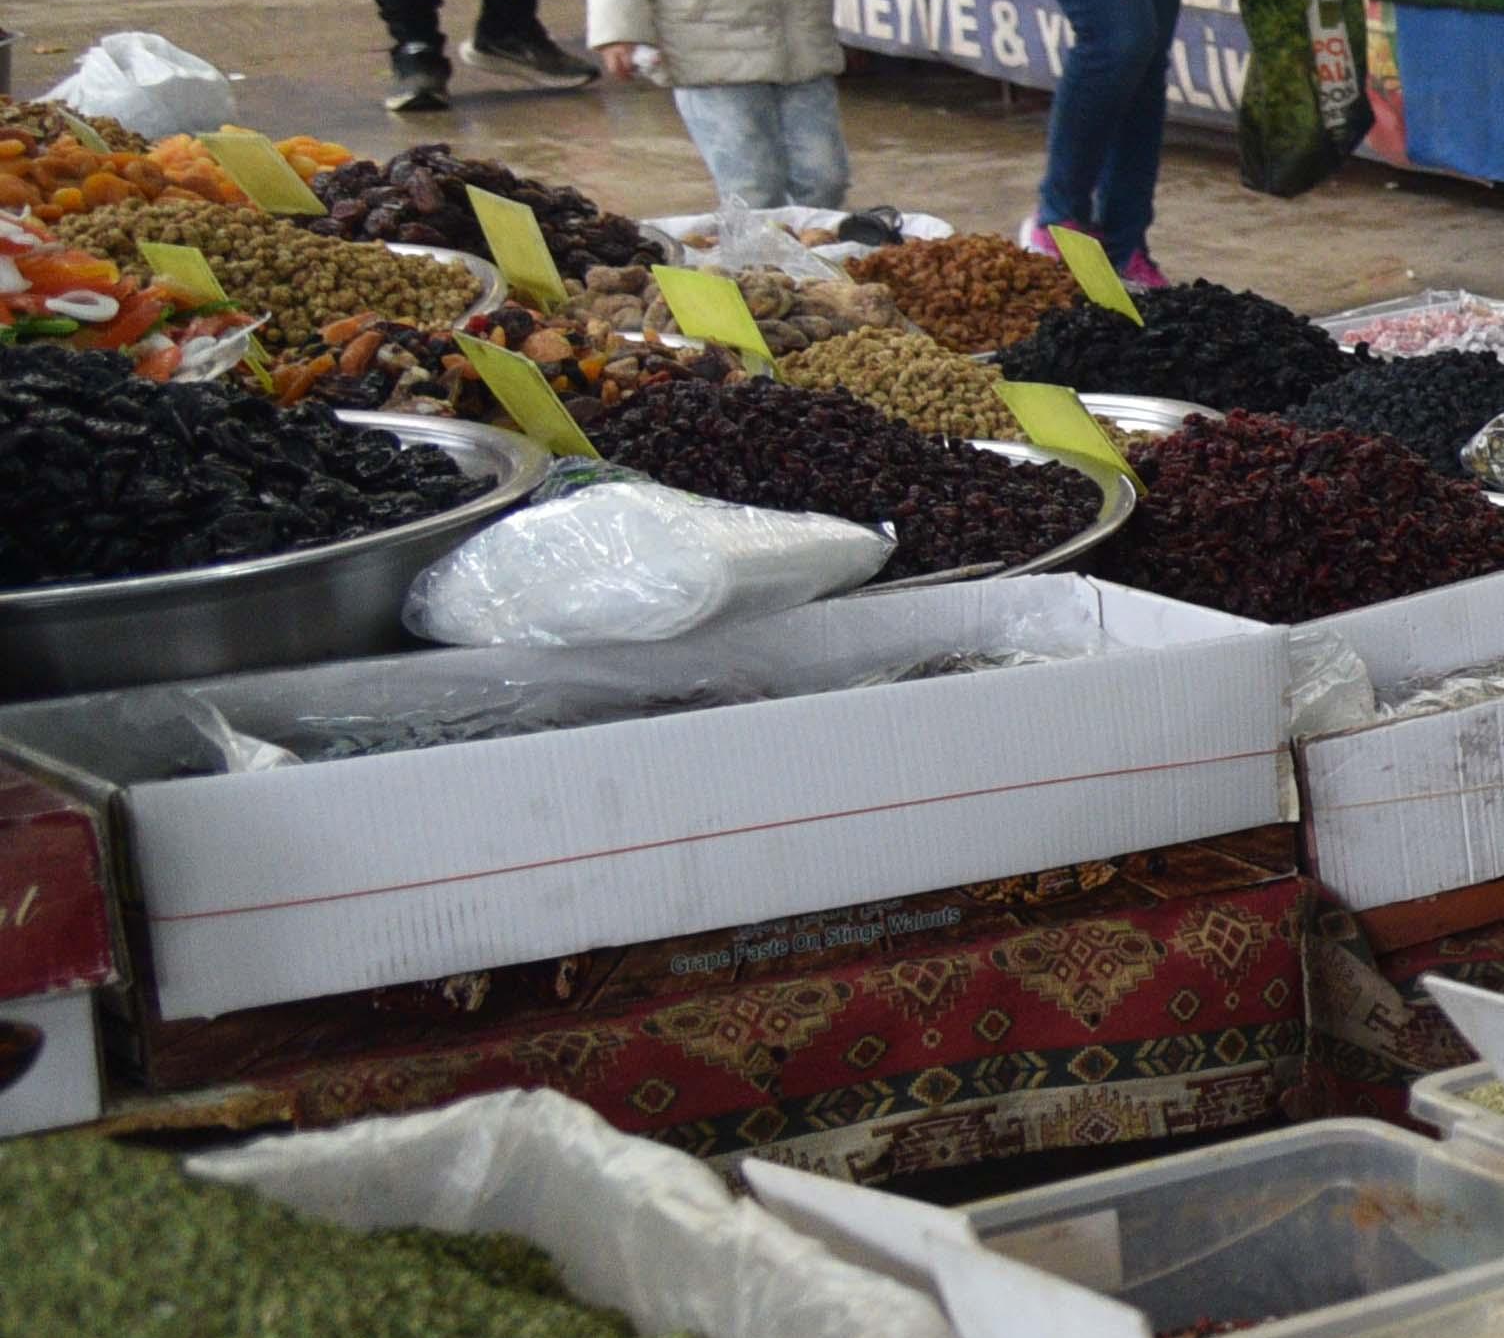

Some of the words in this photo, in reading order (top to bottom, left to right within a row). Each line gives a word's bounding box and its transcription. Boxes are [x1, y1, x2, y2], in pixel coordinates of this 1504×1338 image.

[671, 949, 730, 975] Grape
[733, 937, 789, 963] Paste
[792, 931, 821, 953] On
[888, 905, 961, 935] Walnuts
